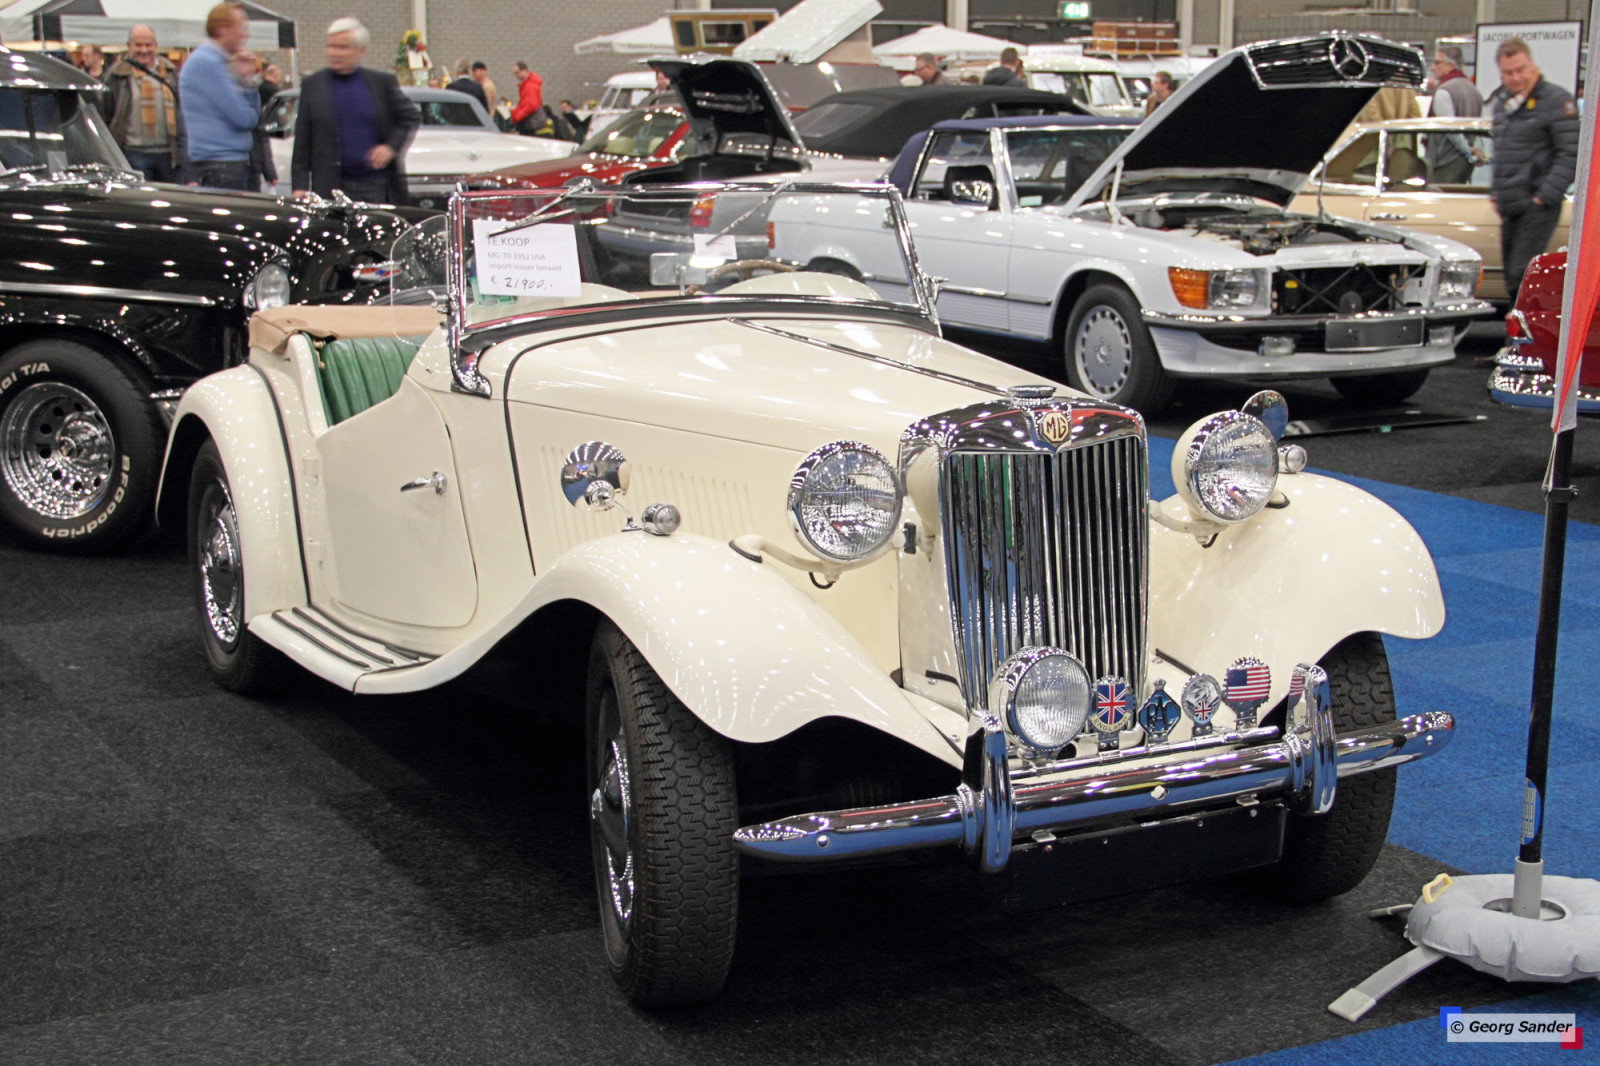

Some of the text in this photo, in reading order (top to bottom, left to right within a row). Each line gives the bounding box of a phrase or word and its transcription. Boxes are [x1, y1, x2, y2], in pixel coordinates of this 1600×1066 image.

[501, 237, 530, 247] KOOP
[514, 253, 530, 261] 1952
[488, 263, 562, 272] import invoer betaald
[20, 362, 50, 376] T/A
[1046, 415, 1067, 439] MG
[42, 455, 130, 539] BFGoodrich
[1146, 696, 1178, 732] RAC
[1093, 716, 1128, 732] ENGLAND
